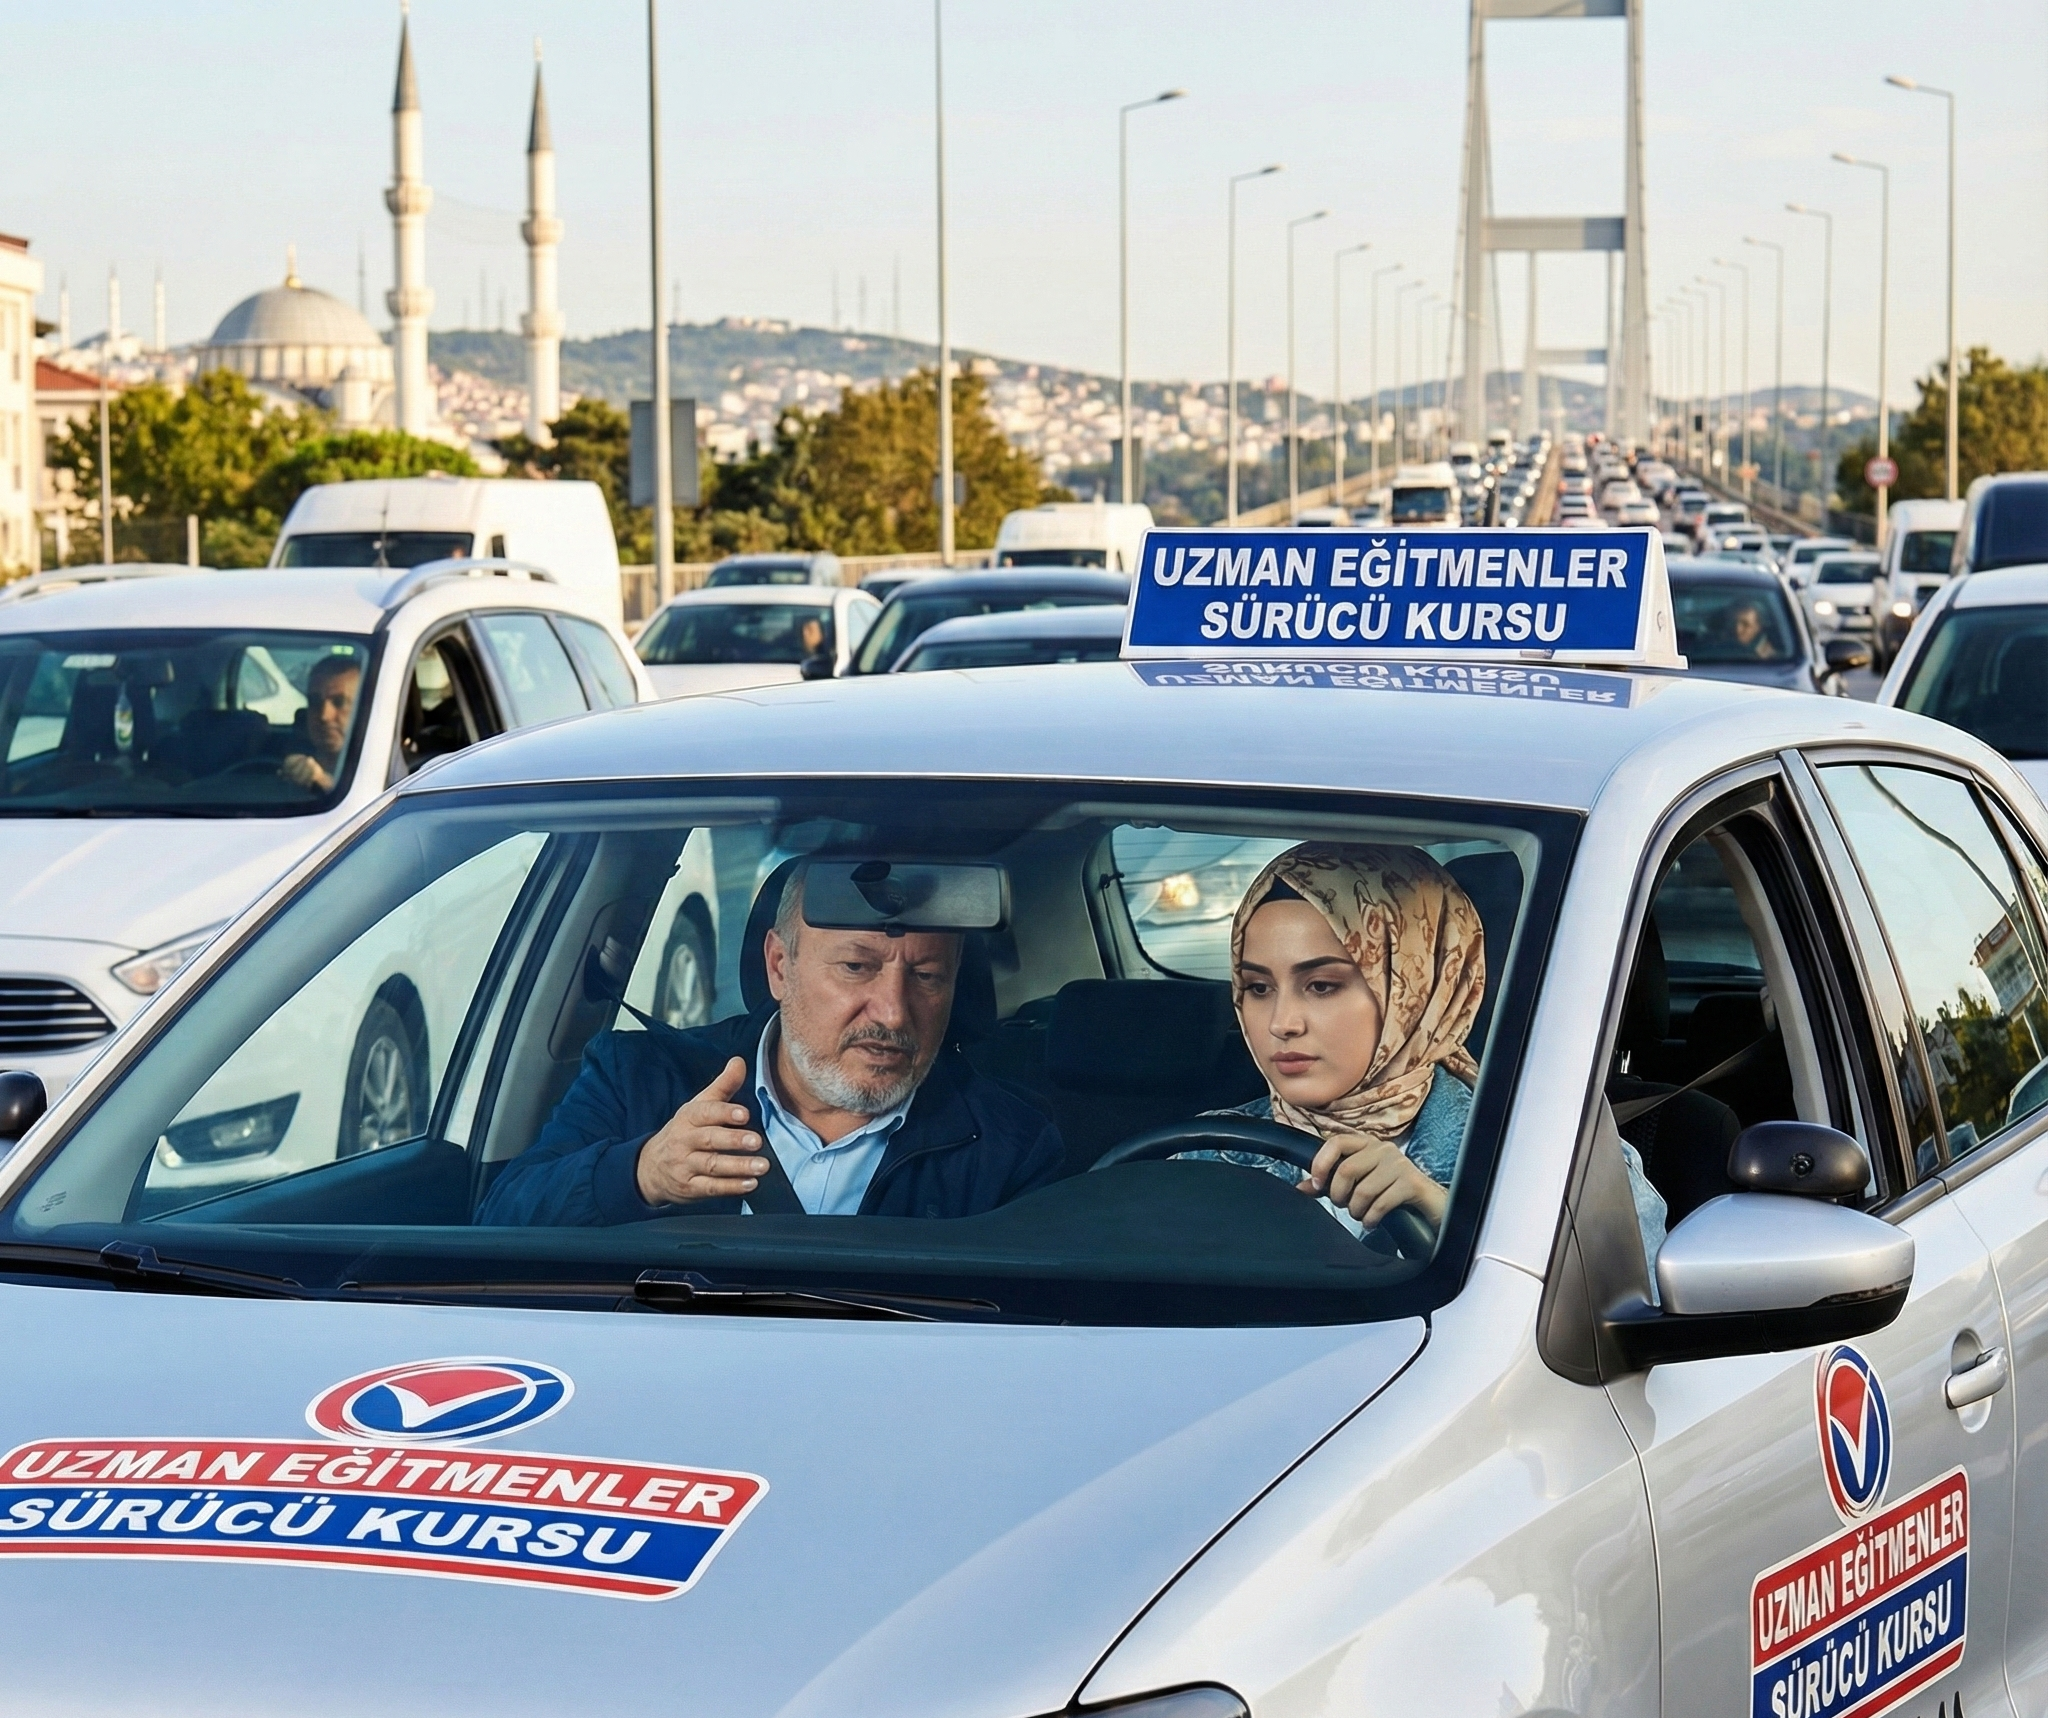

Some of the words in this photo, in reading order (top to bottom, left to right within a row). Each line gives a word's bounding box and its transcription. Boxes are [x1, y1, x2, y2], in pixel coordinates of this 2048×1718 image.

[1153, 547, 1316, 587] UZMAN
[1330, 538, 1629, 588] EĞİTMENLER
[1200, 593, 1391, 640] SÜRÜCÜ
[1404, 602, 1567, 642] KURSU
[11, 1449, 266, 1481] UZMAN
[267, 1447, 735, 1518] EĞİTMENLER
[0, 1490, 337, 1537] SÜRÜCÜ
[346, 1507, 651, 1564] KURSU
[1758, 1560, 1835, 1652] UZMAN
[1841, 1489, 1965, 1607] EĞİTMENLER
[1771, 1618, 1871, 1718] SÜRÜCÜ
[1877, 1578, 1952, 1676] KURSU
